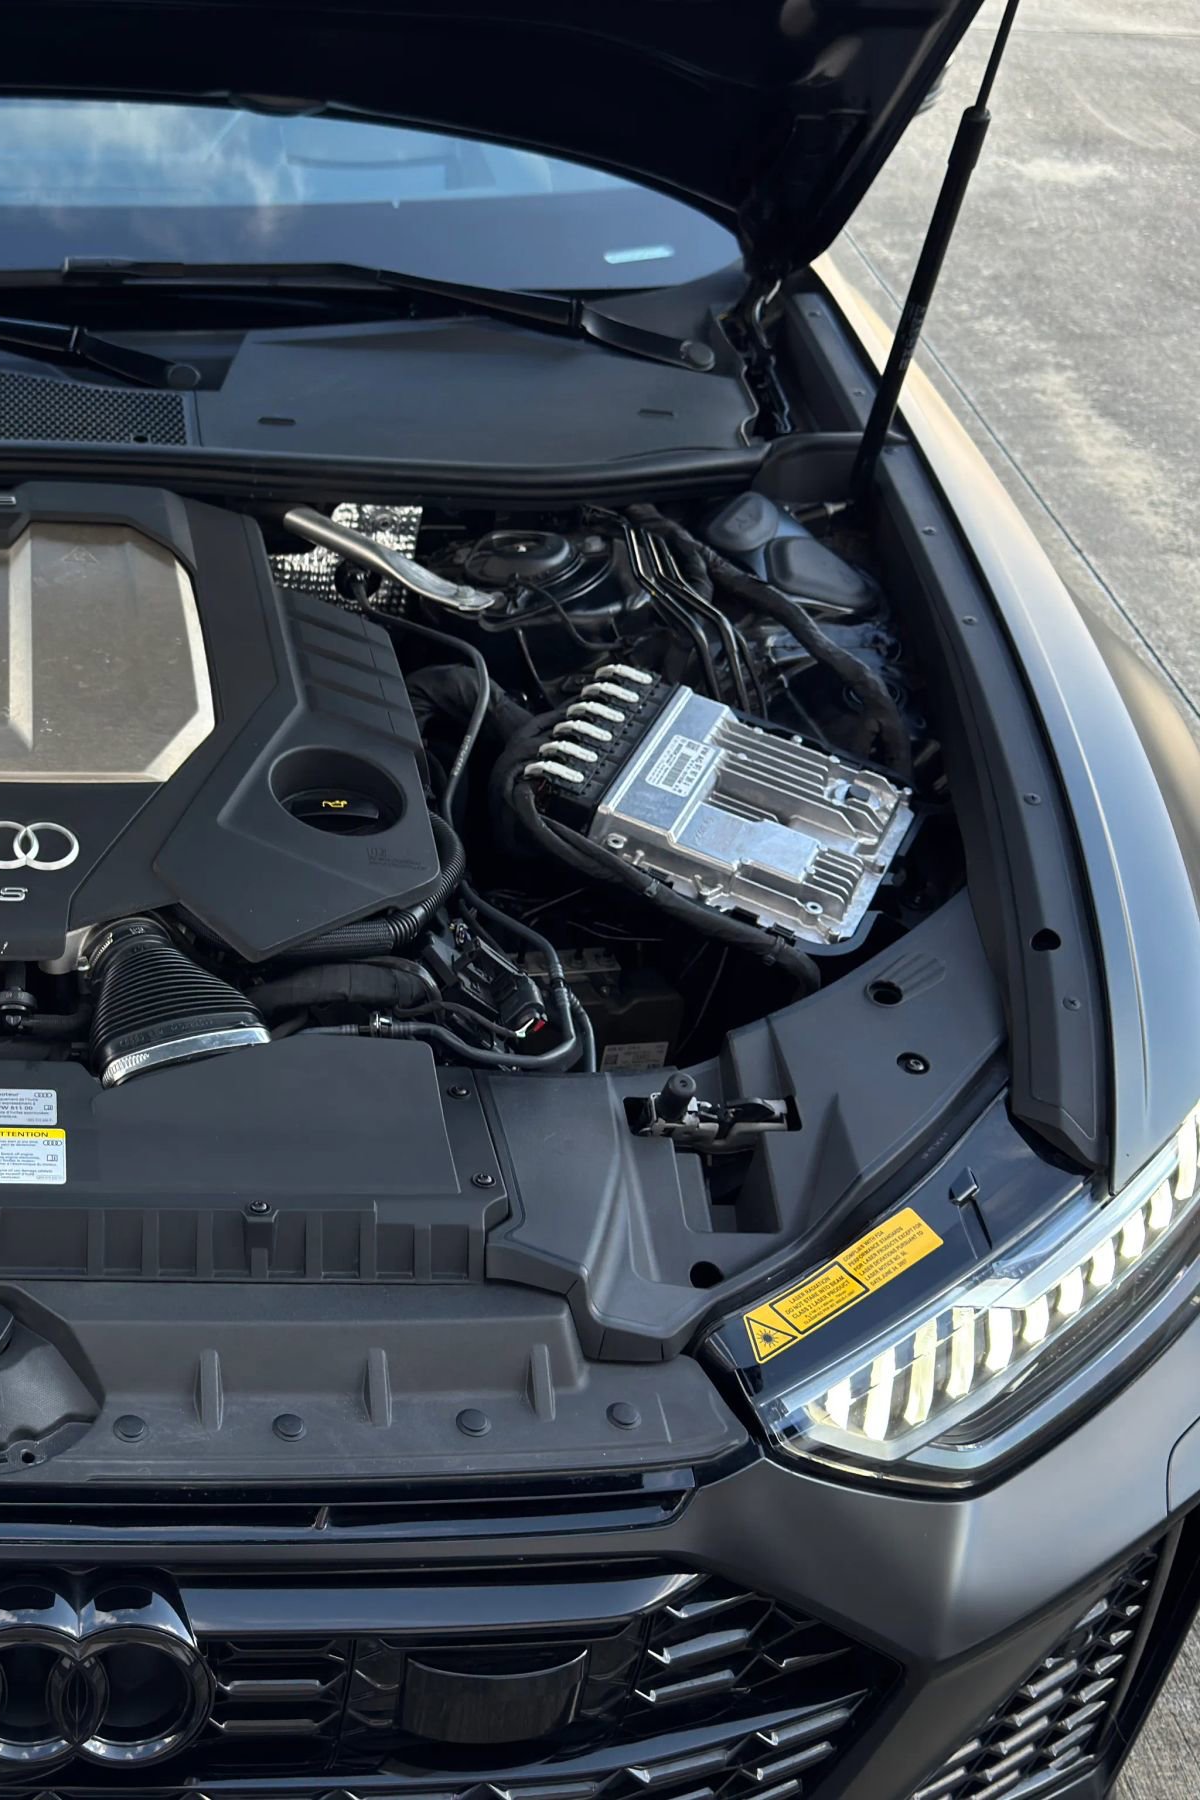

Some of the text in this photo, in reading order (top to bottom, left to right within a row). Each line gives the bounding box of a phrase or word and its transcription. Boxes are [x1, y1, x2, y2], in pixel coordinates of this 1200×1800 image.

[848, 1226, 903, 1267] PERFORMANCE STANDARDS
[854, 1222, 922, 1272] FOR LASER PRODUCTS EXCEPT FOR
[859, 1264, 874, 1276] LASER
[874, 1248, 897, 1267] DEVIATIONS
[896, 1234, 917, 1251] PURSUANT
[864, 1236, 876, 1247] WITH
[875, 1230, 884, 1239] FDA
[789, 1276, 830, 1304] LASER RADIATION
[864, 1269, 879, 1282] LASER
[878, 1259, 894, 1272] NOTICE
[881, 1269, 892, 1279] JUNE
[785, 1275, 845, 1315] DO NOT STARE INTO BEAM
[792, 1306, 809, 1319] CLASS
[811, 1293, 828, 1307] LASER
[827, 1279, 850, 1296] PRODUCT
